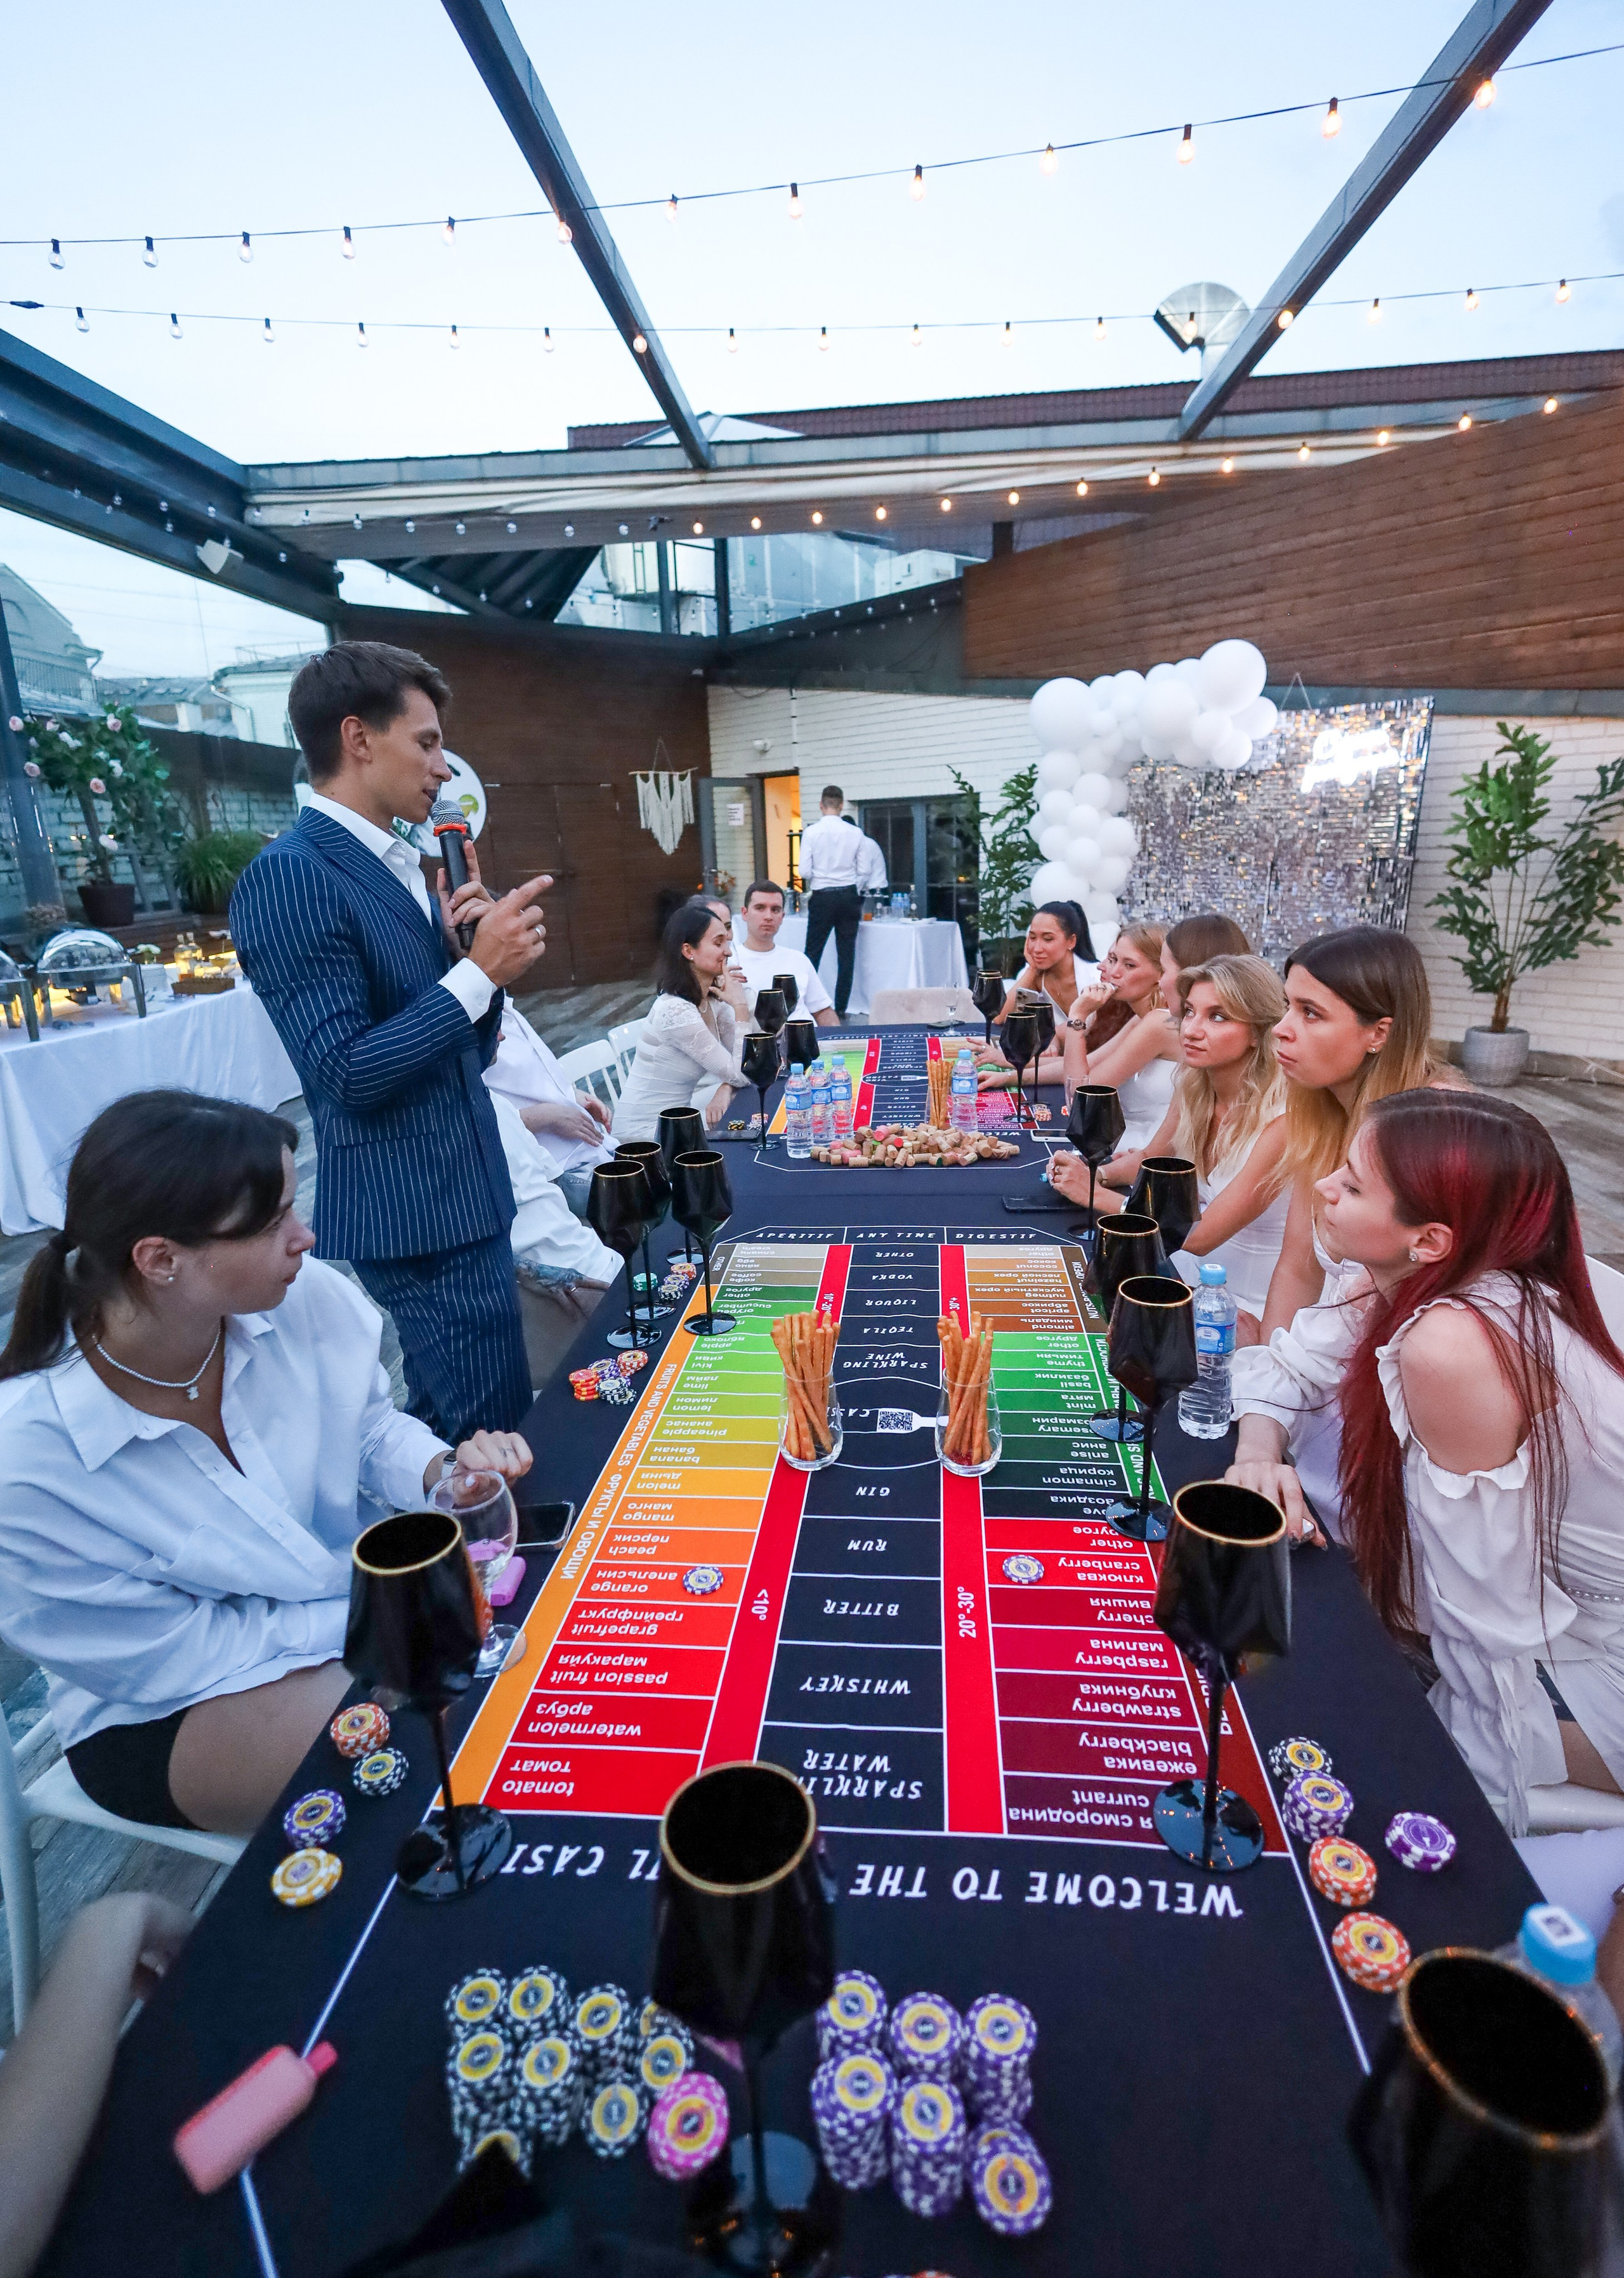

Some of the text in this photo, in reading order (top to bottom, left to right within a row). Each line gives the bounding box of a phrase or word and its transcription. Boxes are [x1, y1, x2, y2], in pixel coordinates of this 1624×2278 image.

[712, 1256, 725, 1271] OTHER
[865, 1352, 905, 1361] WINE
[843, 1359, 928, 1369] SPARKLING
[617, 1363, 678, 1467] FRUITS AND VEGETABLES
[1032, 1417, 1090, 1425] озмарин
[662, 1428, 727, 1437] pineapple
[653, 1446, 695, 1455] банан
[1071, 1451, 1109, 1459] anise
[650, 1455, 700, 1463] banana
[1059, 1467, 1114, 1476] корица
[636, 1483, 681, 1491] melon
[1042, 1477, 1116, 1487] cinnamon
[856, 1486, 890, 1496] GIN
[1050, 1495, 1115, 1506] воздика
[622, 1512, 675, 1521] mango
[560, 1474, 622, 1580] ФРУКТЫ И ОВОЩИ
[1073, 1526, 1119, 1536] ругое
[613, 1533, 670, 1543] персик
[1090, 1539, 1133, 1549] other
[608, 1545, 657, 1555] peach
[847, 1539, 887, 1552] RUM
[1058, 1557, 1140, 1570] cranberry
[596, 1570, 678, 1580] апельсин
[1077, 1573, 1144, 1583] клюква
[591, 1581, 648, 1593] orange
[751, 1589, 769, 1621] <10°
[823, 1599, 899, 1616] BITTER
[1090, 1597, 1151, 1609] вишня
[578, 1607, 683, 1623] грейпфрукт
[1097, 1609, 1154, 1625] cherry
[571, 1623, 658, 1637] grapefruit
[1090, 1639, 1164, 1652] малина
[558, 1653, 648, 1667] маракуйя
[1075, 1651, 1169, 1669] raspberry
[550, 1670, 668, 1686] passion fruit
[799, 1675, 910, 1694] WHISKEY
[1080, 1684, 1176, 1699] клубника
[536, 1701, 593, 1718] арбуз
[1072, 1698, 1182, 1719] strawberry
[528, 1722, 641, 1738] watermelon
[1078, 1732, 1193, 1757] blackberry
[510, 1760, 571, 1772] томат
[803, 1749, 891, 1772] WATER
[1104, 1757, 1197, 1774] ежевика
[502, 1780, 574, 1797] tomato
[1071, 1790, 1149, 1807] currant
[1009, 1807, 1133, 1827] смородина
[501, 1844, 605, 1876] CASI
[849, 1864, 927, 1897] THE
[952, 1867, 1002, 1901] TO
[1025, 1871, 1243, 1918] WELCOME
